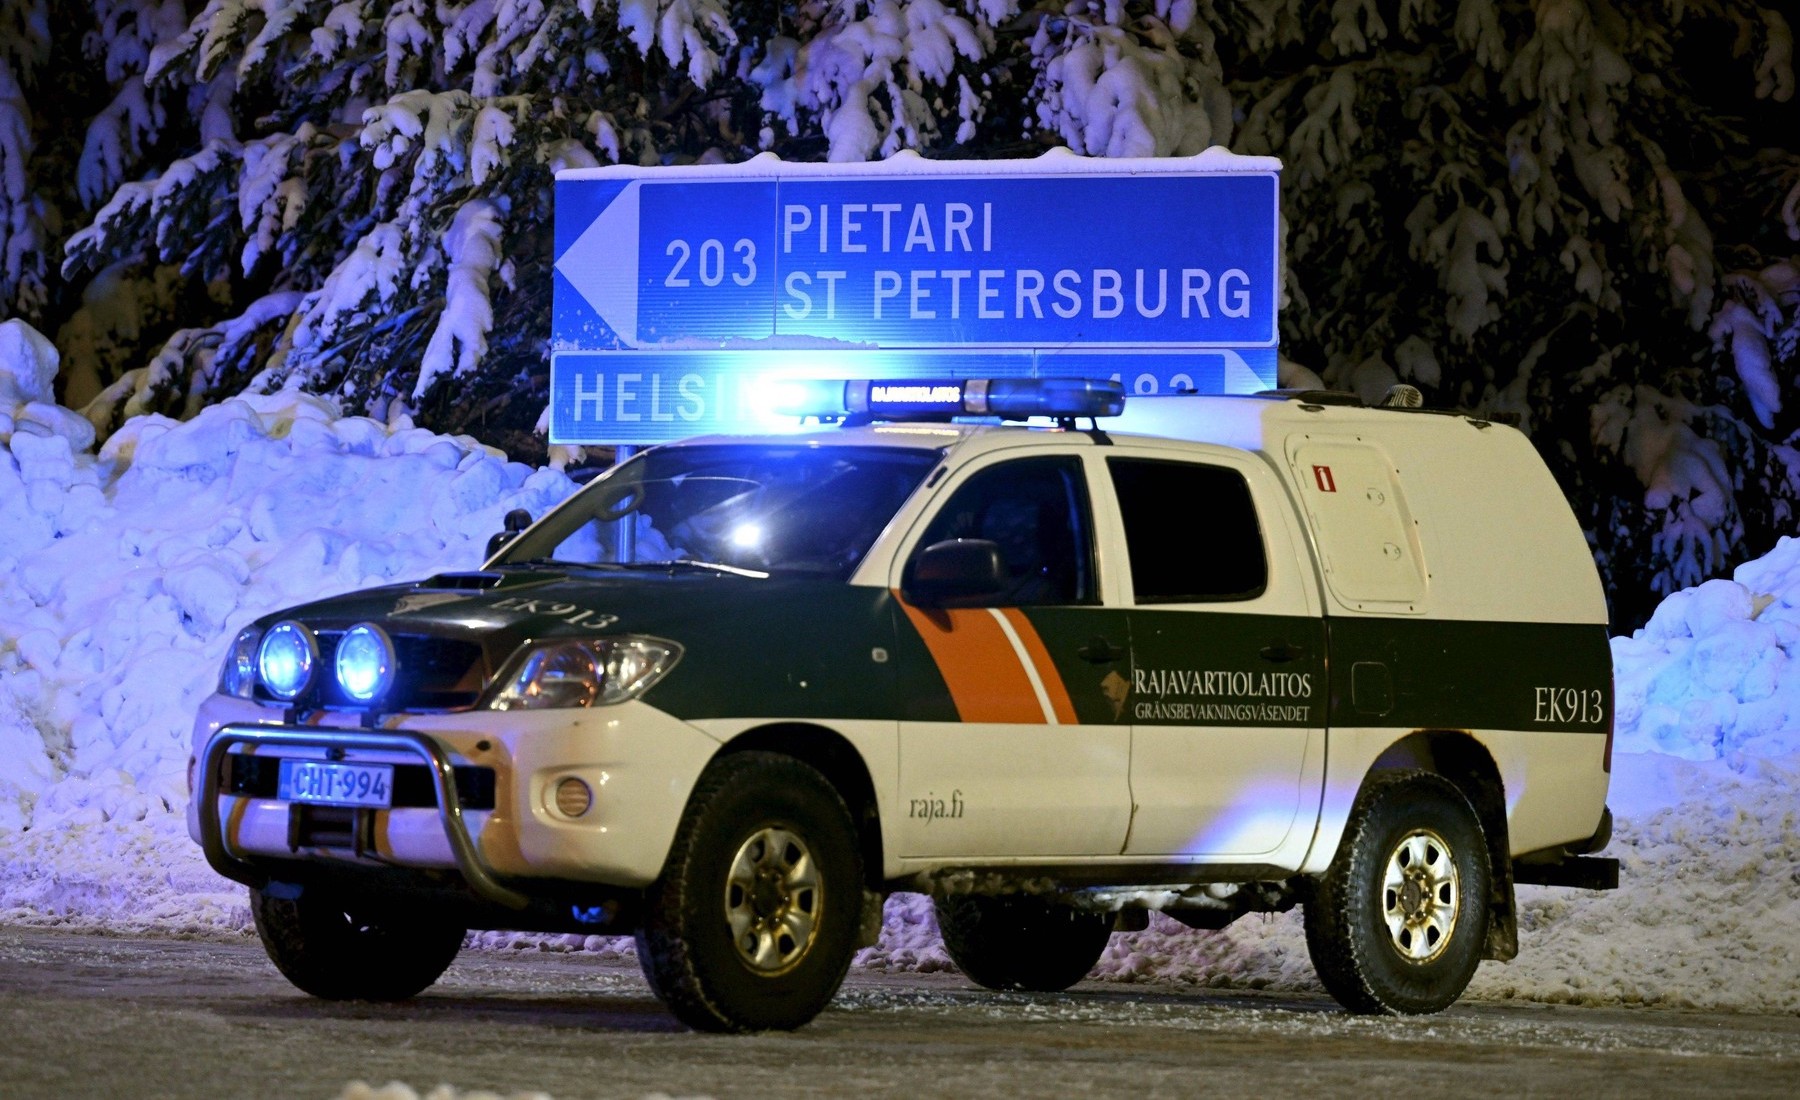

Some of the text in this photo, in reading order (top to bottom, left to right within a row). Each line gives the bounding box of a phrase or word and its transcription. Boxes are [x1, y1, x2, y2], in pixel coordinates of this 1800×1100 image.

[783, 202, 992, 253] PIETARI
[664, 238, 757, 287] 203
[783, 268, 1252, 320] ST PETERSBURG
[573, 373, 750, 422] HELSI
[489, 597, 620, 630] EK913
[1134, 669, 1312, 699] RAJAVARTIOLAITOS
[1134, 702, 1311, 722] GRÄNSBEVAKNINGSVÄSENDET
[1533, 686, 1604, 724] EK913
[295, 766, 386, 801] CHT-994
[909, 788, 964, 828] raja.fi
